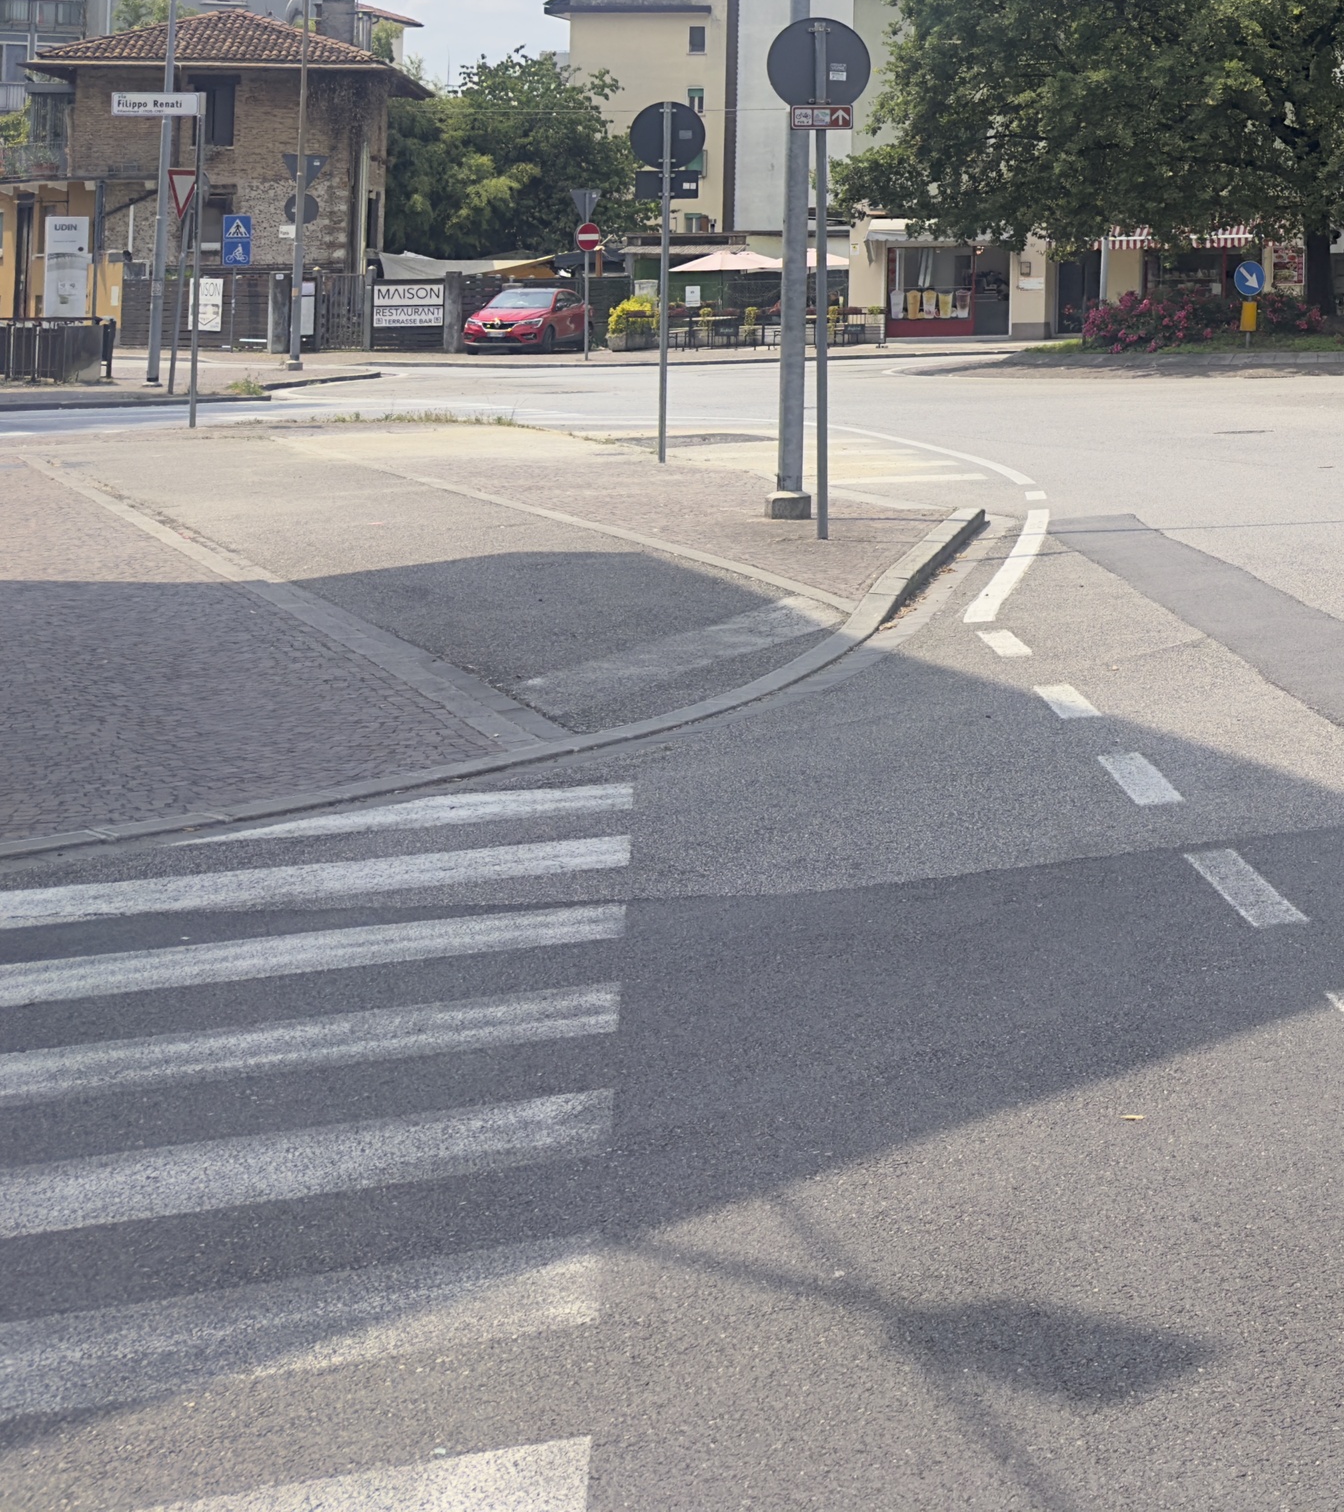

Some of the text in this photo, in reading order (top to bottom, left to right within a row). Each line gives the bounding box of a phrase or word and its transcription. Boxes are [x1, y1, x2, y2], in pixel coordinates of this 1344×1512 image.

[117, 99, 183, 109] Filippo Renati
[54, 223, 77, 231] UDIN
[378, 287, 440, 299] MAISON
[376, 308, 440, 316] RESTAURANT
